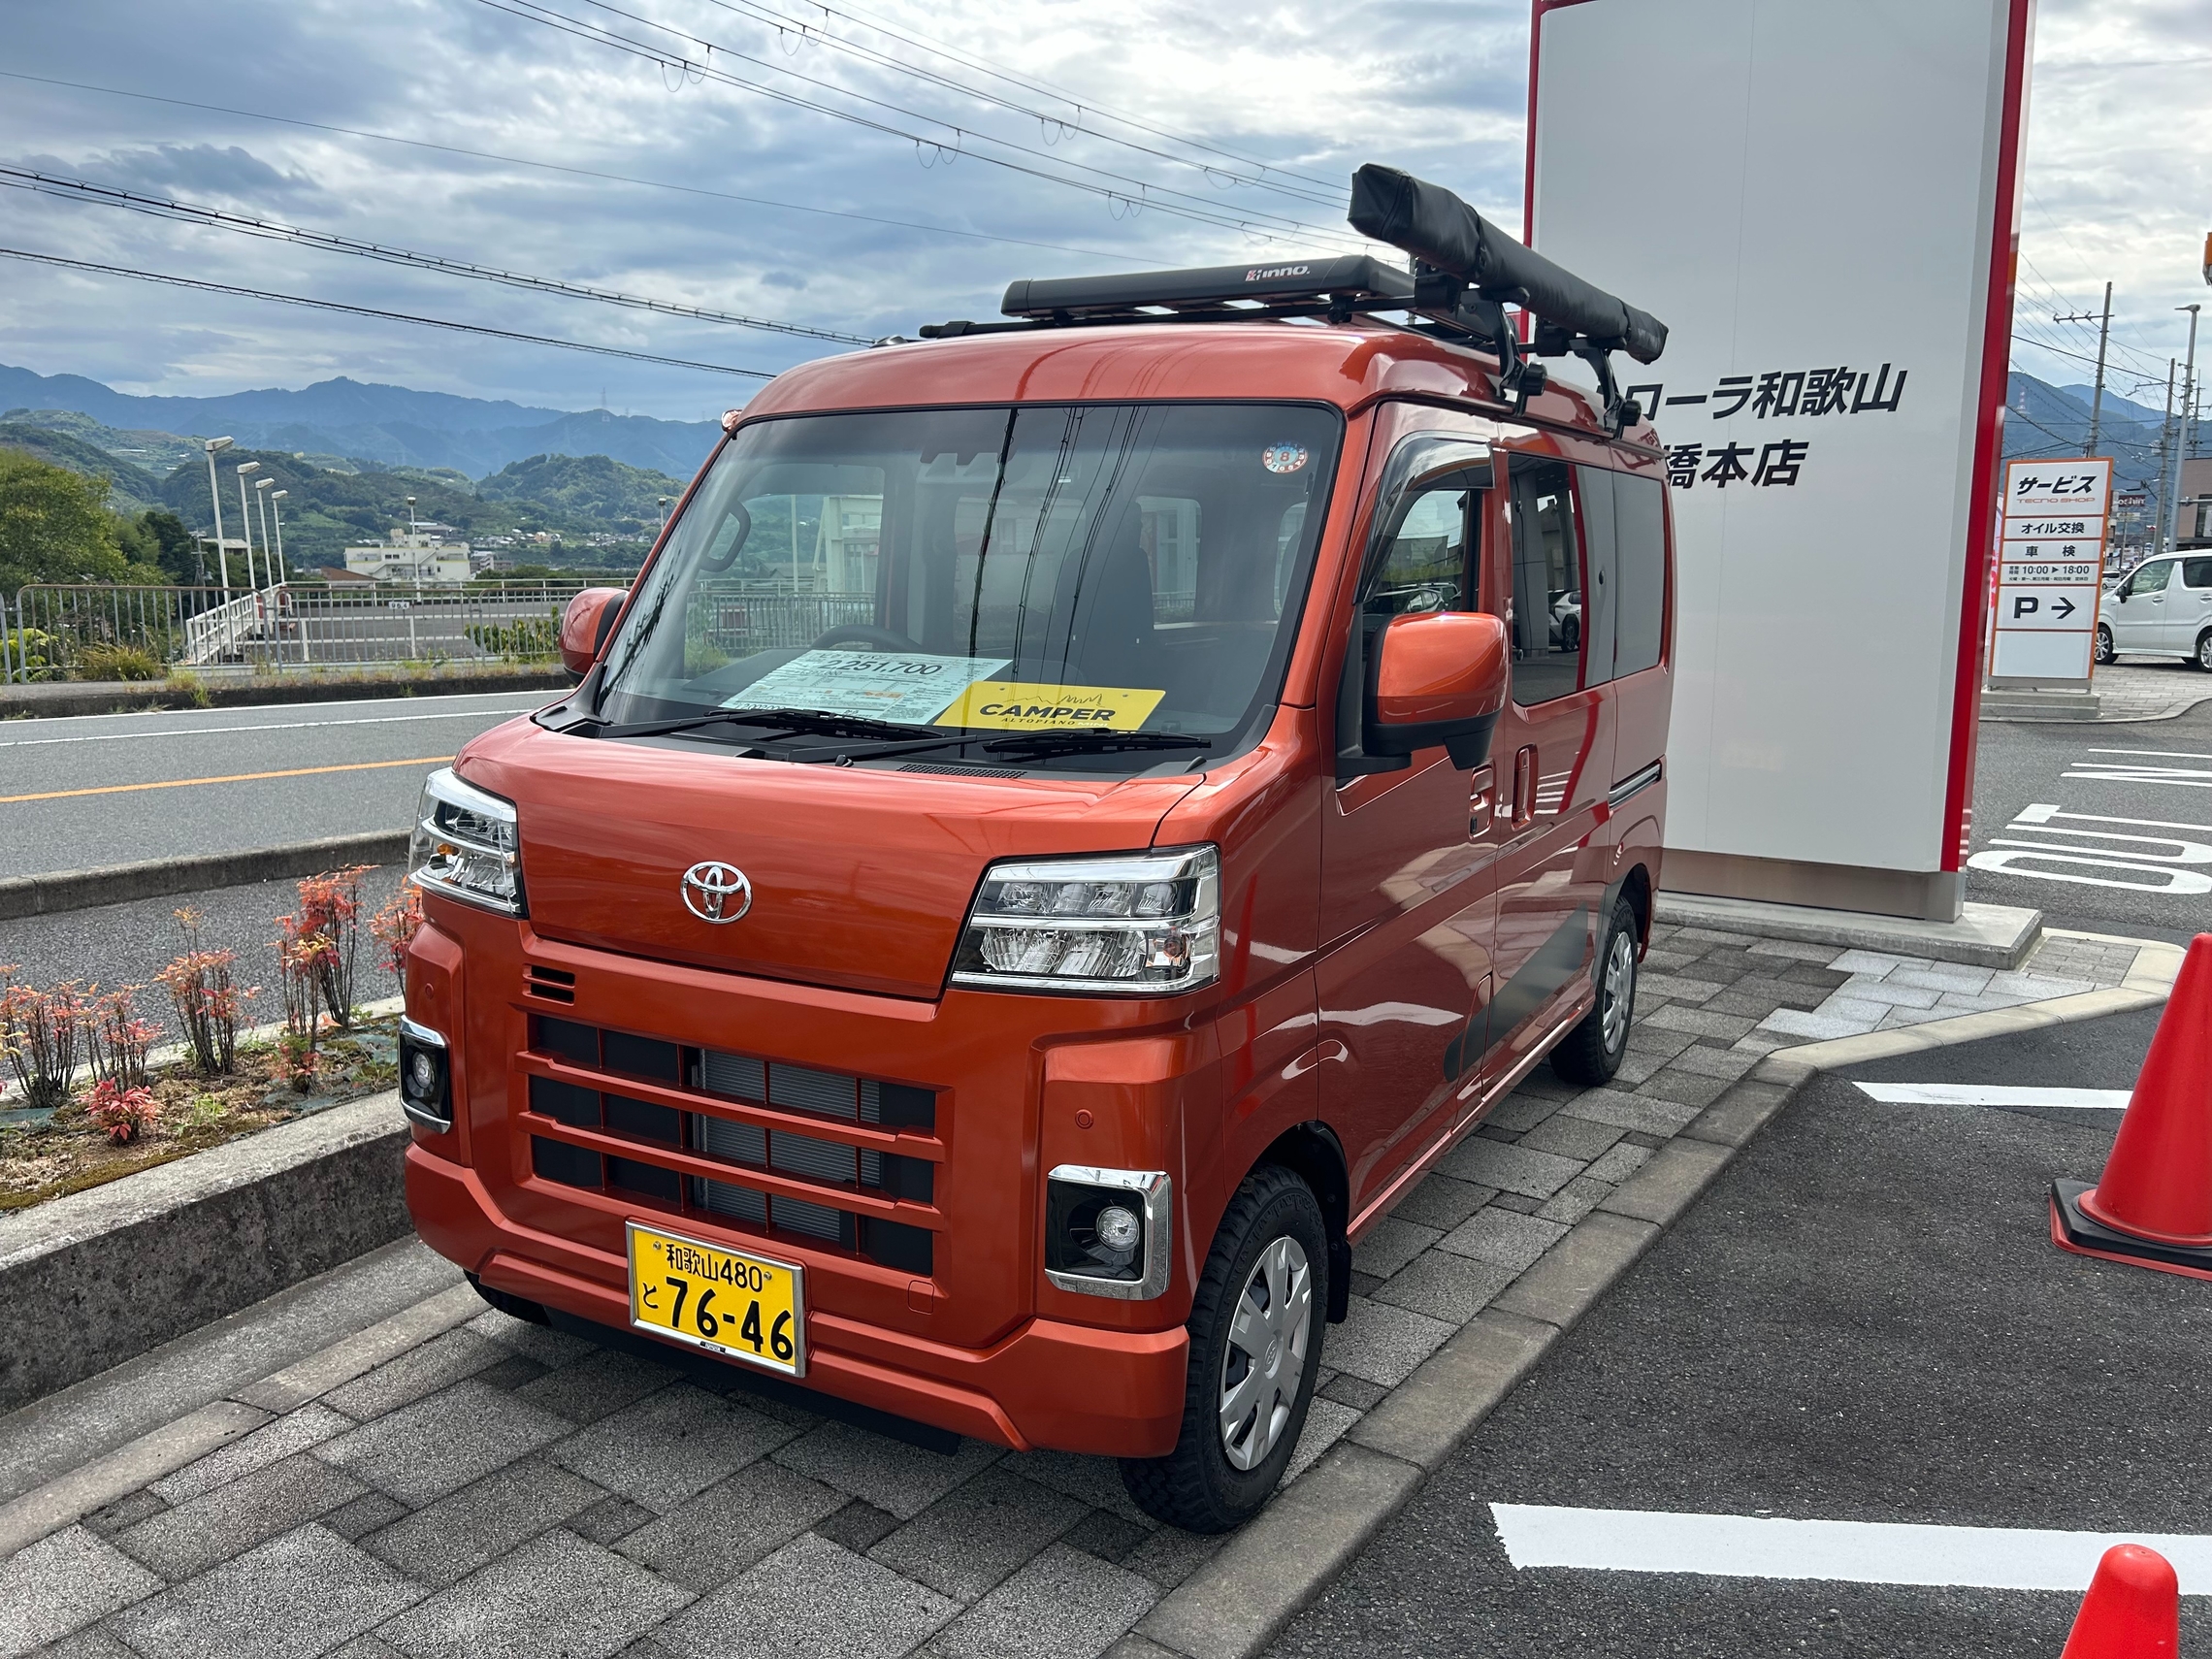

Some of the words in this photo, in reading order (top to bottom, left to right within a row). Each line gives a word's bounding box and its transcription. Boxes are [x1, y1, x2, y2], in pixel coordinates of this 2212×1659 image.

[1664, 439, 1809, 489] 橋本店
[2017, 475, 2097, 496] サービス
[2021, 522, 2085, 534] オイル交換
[2022, 565, 2049, 574] 10:00
[2063, 565, 2090, 574] 18:00
[2013, 597, 2038, 619] P
[817, 659, 943, 676] 2,251,700
[979, 703, 1116, 721] CAMPER
[666, 1243, 763, 1293] 和歌山480
[642, 1282, 659, 1309] と
[666, 1276, 794, 1361] 76-46
